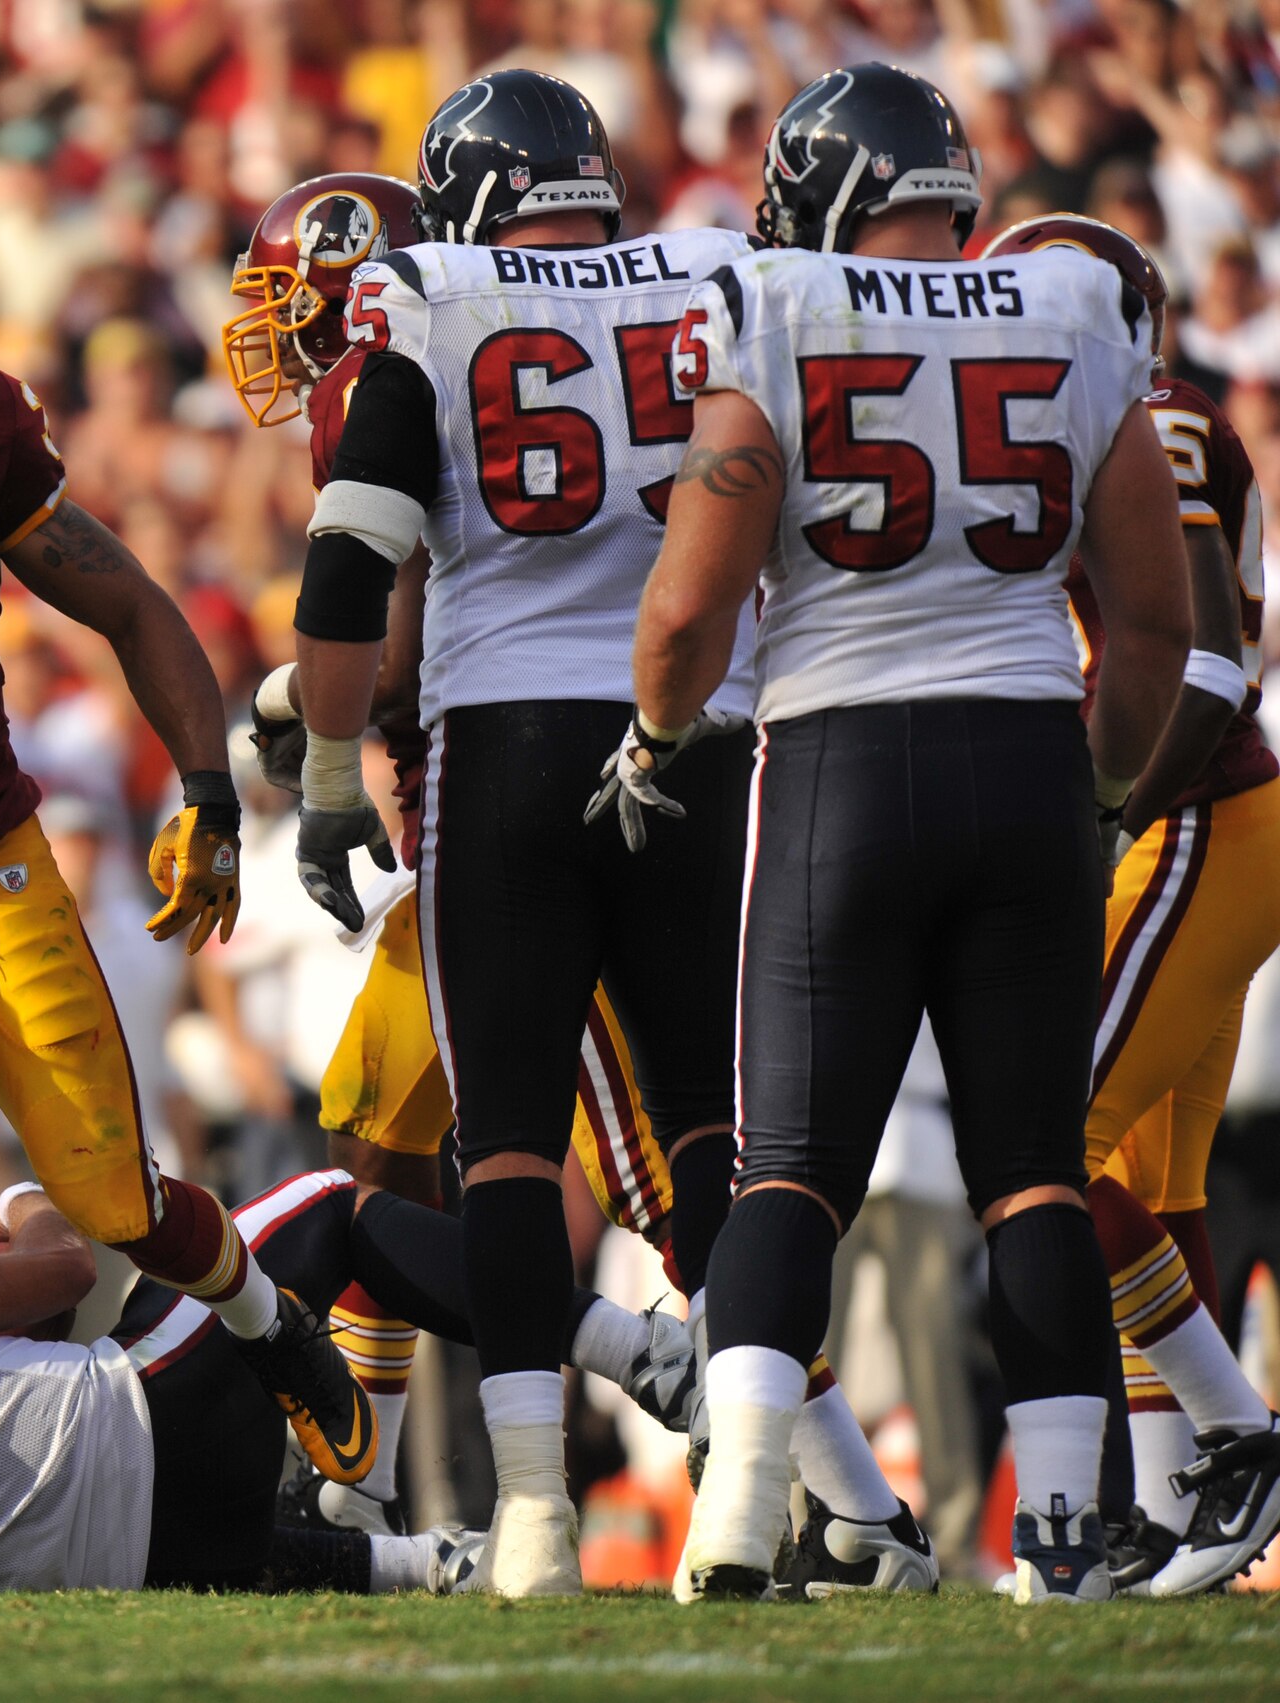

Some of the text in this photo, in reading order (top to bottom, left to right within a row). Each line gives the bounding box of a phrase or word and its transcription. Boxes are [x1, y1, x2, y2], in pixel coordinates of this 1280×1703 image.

[531, 190, 610, 202] TEXANS
[910, 180, 972, 190] TEXANS
[492, 244, 690, 289] BRISIEL
[843, 267, 1025, 317] MYERS
[342, 282, 391, 353] 5
[676, 308, 709, 388] 5
[797, 353, 1073, 574] 55
[663, 1357, 681, 1370] NIKE
